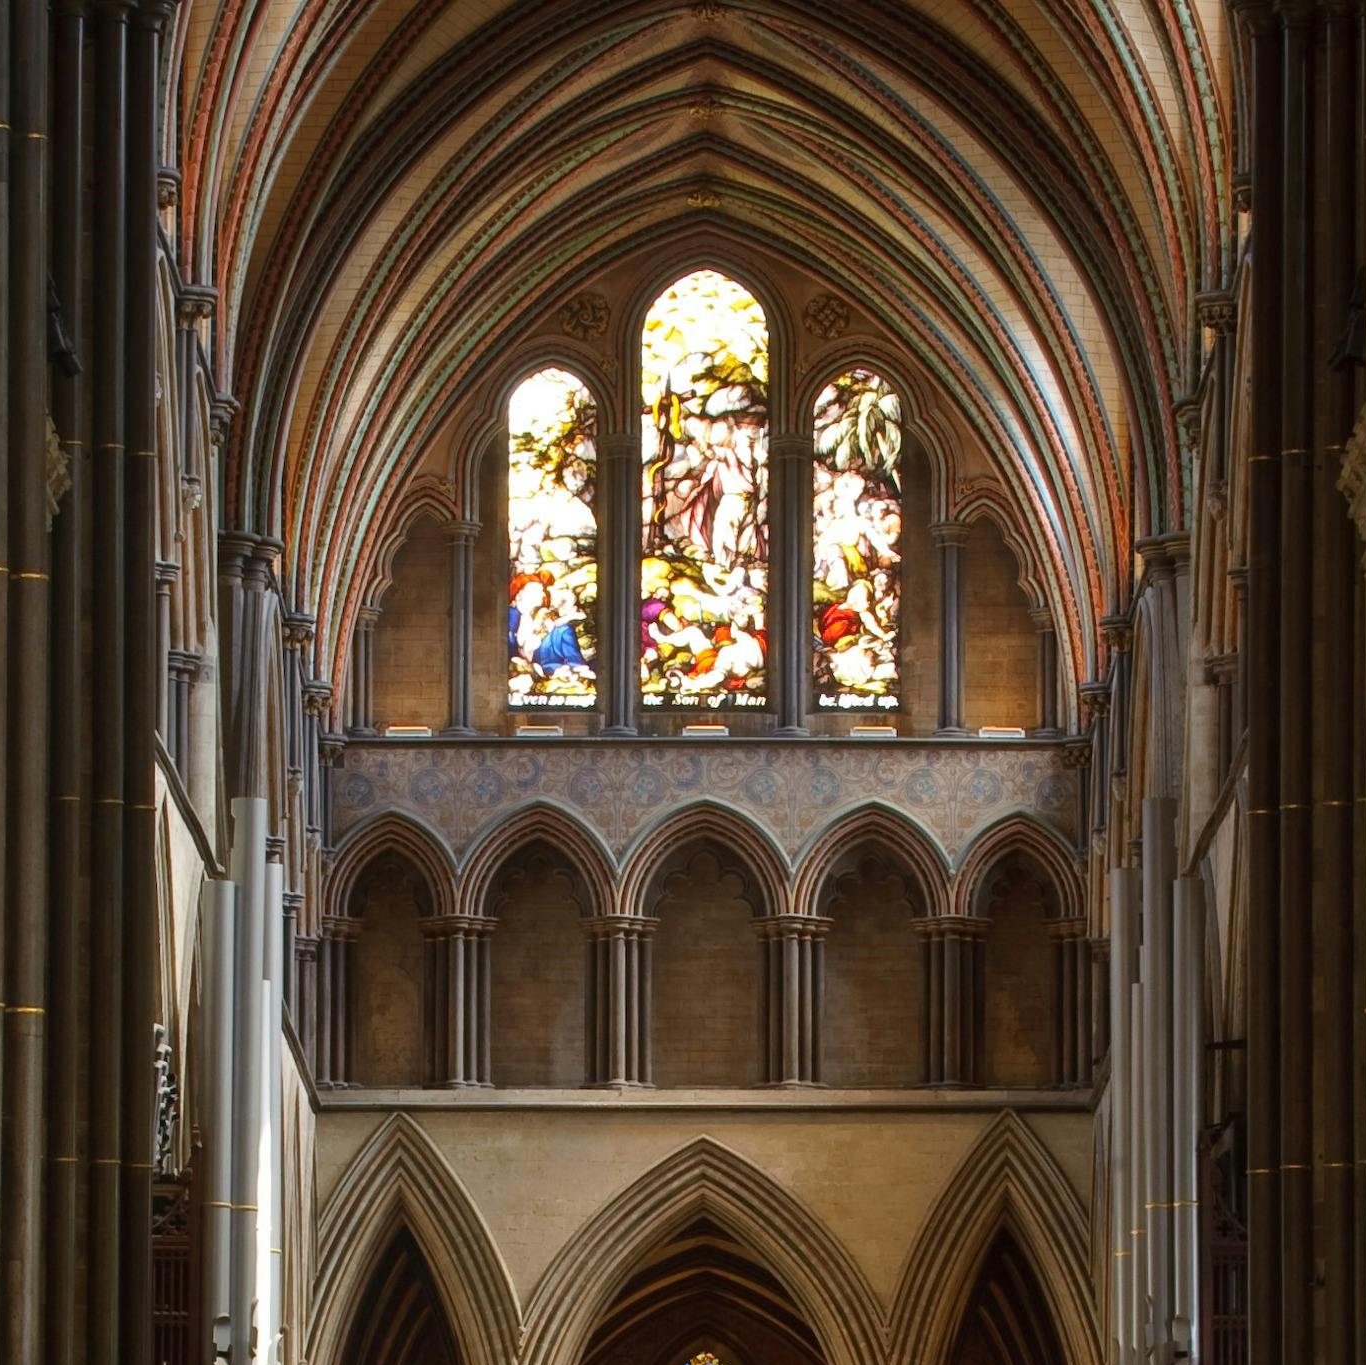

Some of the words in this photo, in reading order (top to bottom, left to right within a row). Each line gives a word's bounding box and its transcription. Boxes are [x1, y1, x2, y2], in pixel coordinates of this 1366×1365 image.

[643, 693, 664, 706] the
[672, 693, 699, 706] Son
[707, 693, 726, 708] of
[735, 693, 766, 706] Man
